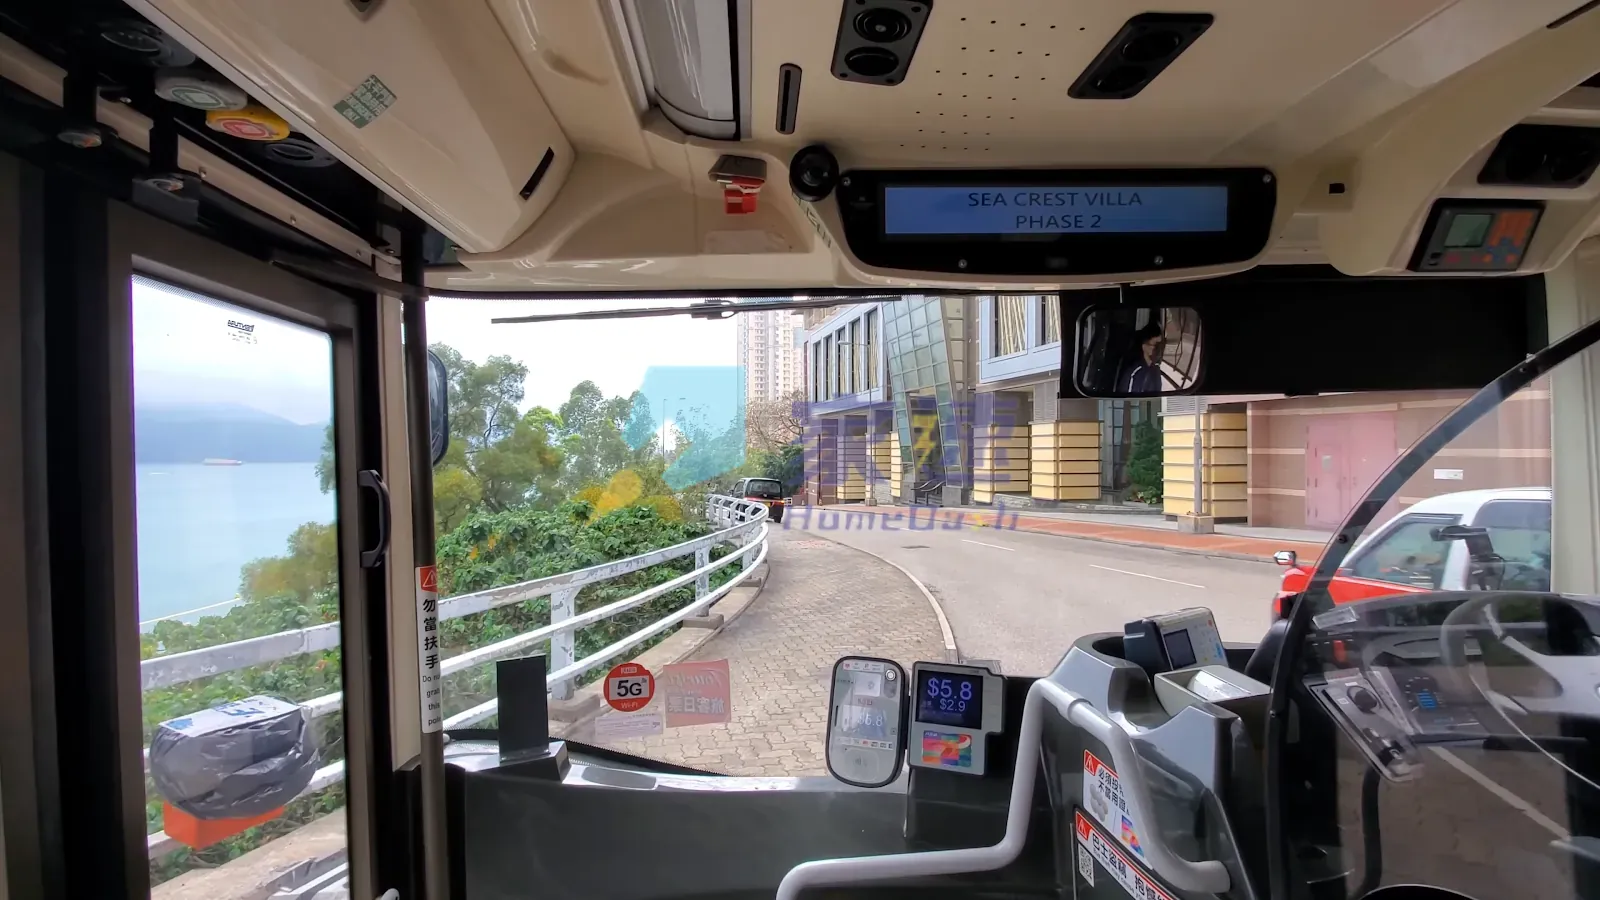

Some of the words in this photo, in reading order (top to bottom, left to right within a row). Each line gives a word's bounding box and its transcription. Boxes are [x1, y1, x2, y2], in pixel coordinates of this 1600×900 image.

[968, 192, 1007, 207] SEA
[1014, 192, 1079, 207] CREST
[1084, 191, 1142, 207] VILLA
[1015, 214, 1084, 229] PHASE
[1090, 214, 1102, 229] 2
[422, 598, 439, 669] 勿當扶手
[616, 679, 642, 697] 5G
[927, 677, 973, 701] $5.8
[428, 703, 440, 711] this
[939, 698, 966, 712] $2.9
